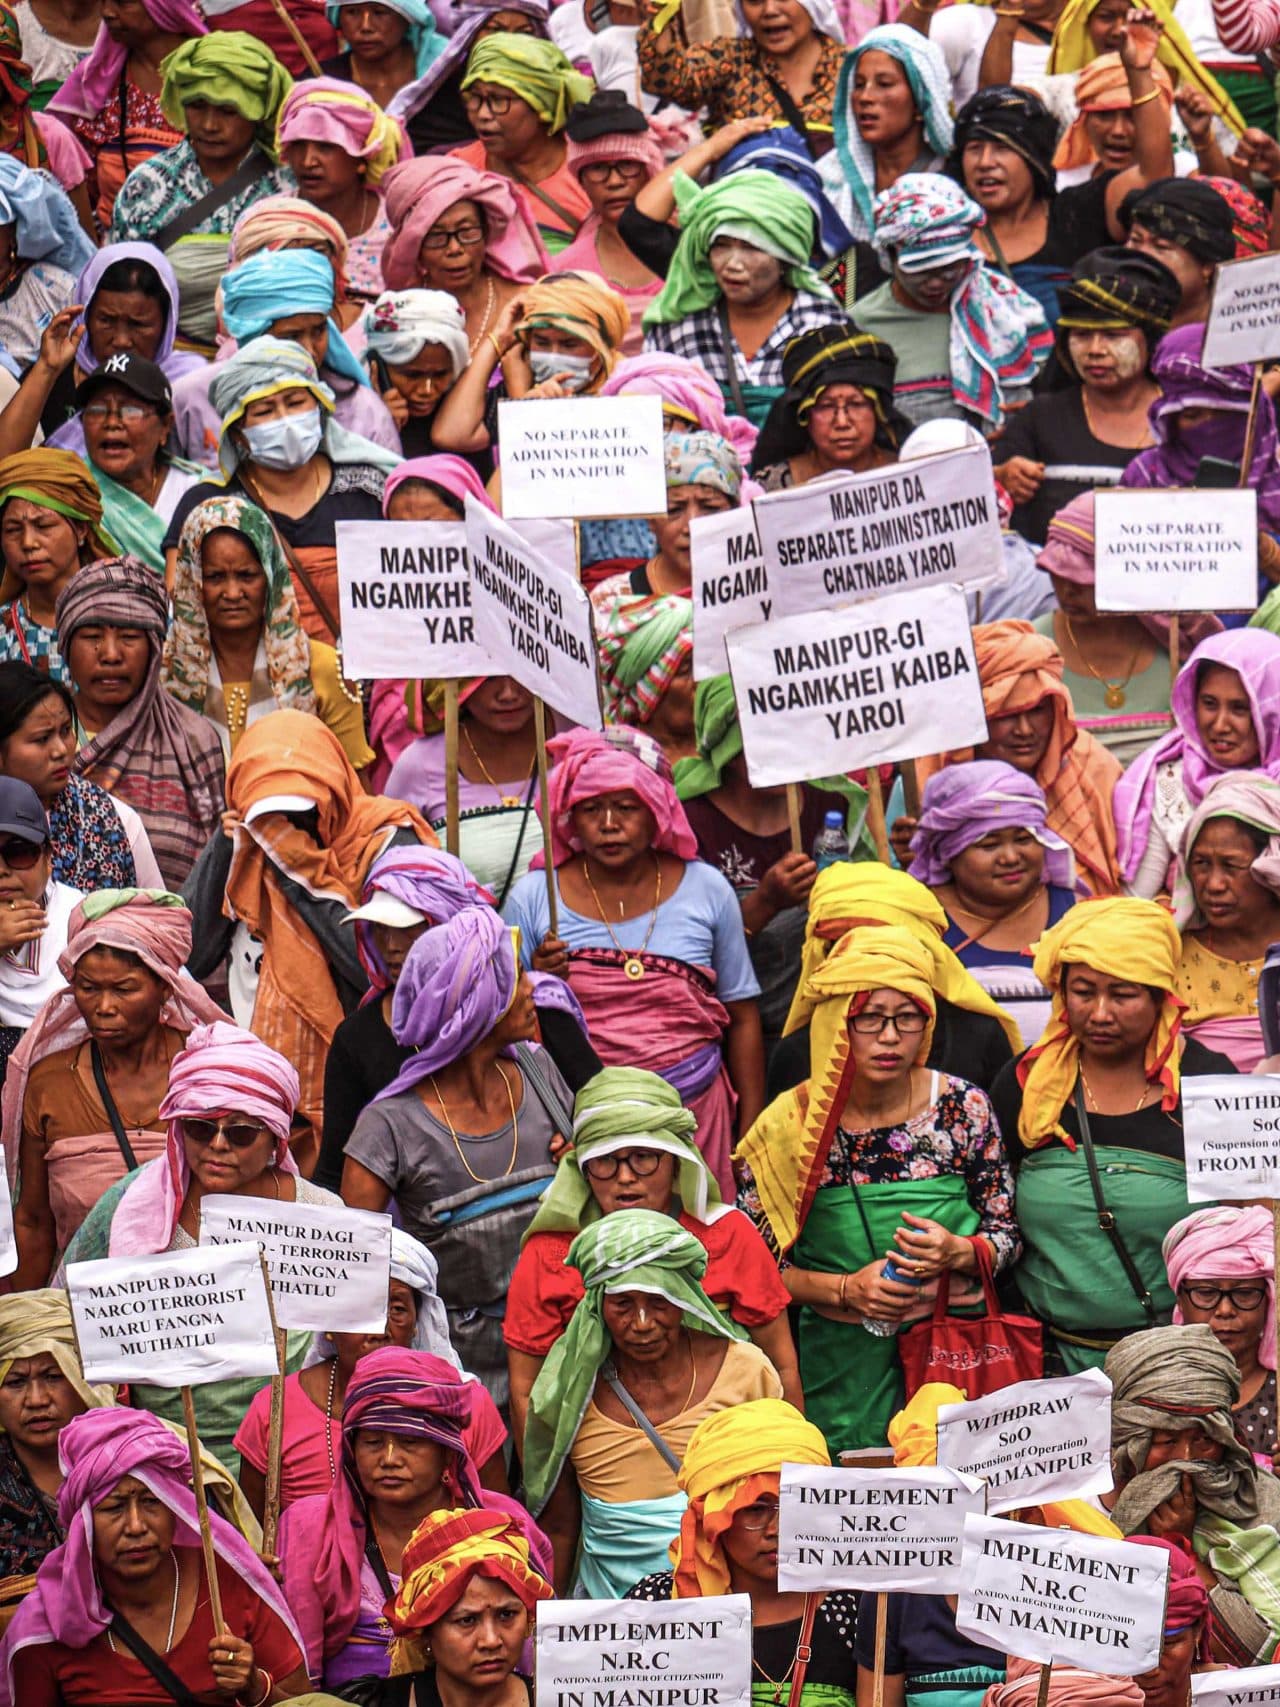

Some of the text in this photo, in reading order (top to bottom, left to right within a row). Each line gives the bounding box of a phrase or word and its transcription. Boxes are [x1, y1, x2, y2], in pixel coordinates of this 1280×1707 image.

[1231, 321, 1242, 332] IN
[104, 354, 130, 373] NY
[524, 427, 631, 441] NO SEPARATE
[510, 445, 649, 462] ADMINISTRATION
[530, 465, 625, 480] IN MANIPUR
[830, 474, 925, 521] MANIPUR DA
[777, 496, 989, 566] SEPARATE ADMINISTRATION
[1120, 523, 1223, 535] NO SEPARATE
[1107, 541, 1242, 554] ADMINISTRATION
[823, 542, 956, 594] CHATNABA YAROI
[1124, 560, 1218, 572] IN MANIPUR
[485, 535, 562, 619] MANIPUR-GI
[473, 556, 589, 668] NGAMKHEI KAIBA
[508, 619, 550, 672] YAROI
[774, 619, 924, 675] MANIPUR-GI
[748, 647, 970, 714] NGAMKHEI KAIBA
[826, 699, 905, 740] YAROI
[1203, 1138, 1268, 1151] (Suspension
[1198, 1156, 1256, 1172] FROM
[227, 1218, 354, 1243] MANIPUR DAGI
[280, 1244, 371, 1263] TERRORIST
[279, 1263, 349, 1280] FANGNA
[88, 1273, 216, 1299] MANIPUR DAGI
[84, 1289, 246, 1320] NARCO TERRORIST
[99, 1312, 224, 1338] MARU FANGNA
[120, 1333, 216, 1356] MUTHATLU
[967, 1396, 1073, 1433] WITHDRAW
[999, 1426, 1032, 1447] SoO
[1014, 1448, 1027, 1458] of
[1028, 1436, 1088, 1457] Operation)
[1005, 1451, 1093, 1484] MANIPUR
[800, 1487, 958, 1505] IMPLEMENT
[840, 1515, 907, 1532] N.R.C
[795, 1534, 842, 1544] (NATIONAL
[901, 1536, 958, 1544] CITIZENSHIP)
[798, 1548, 954, 1567] IN MANIPUR
[983, 1539, 1139, 1584] IMPLEMENT
[1020, 1574, 1087, 1603] N.R.C
[974, 1589, 1135, 1625] (NATIONAL REGISTER OF CITIZENSHIP)
[558, 1621, 723, 1642] IMPLEMENT
[976, 1603, 1130, 1648] IN MANIPUR
[601, 1651, 670, 1671] N.R.C
[604, 1674, 649, 1682] REGISTER
[663, 1672, 723, 1681] CITIZENSHIP)
[557, 1687, 720, 1707] IN MANIPUR
